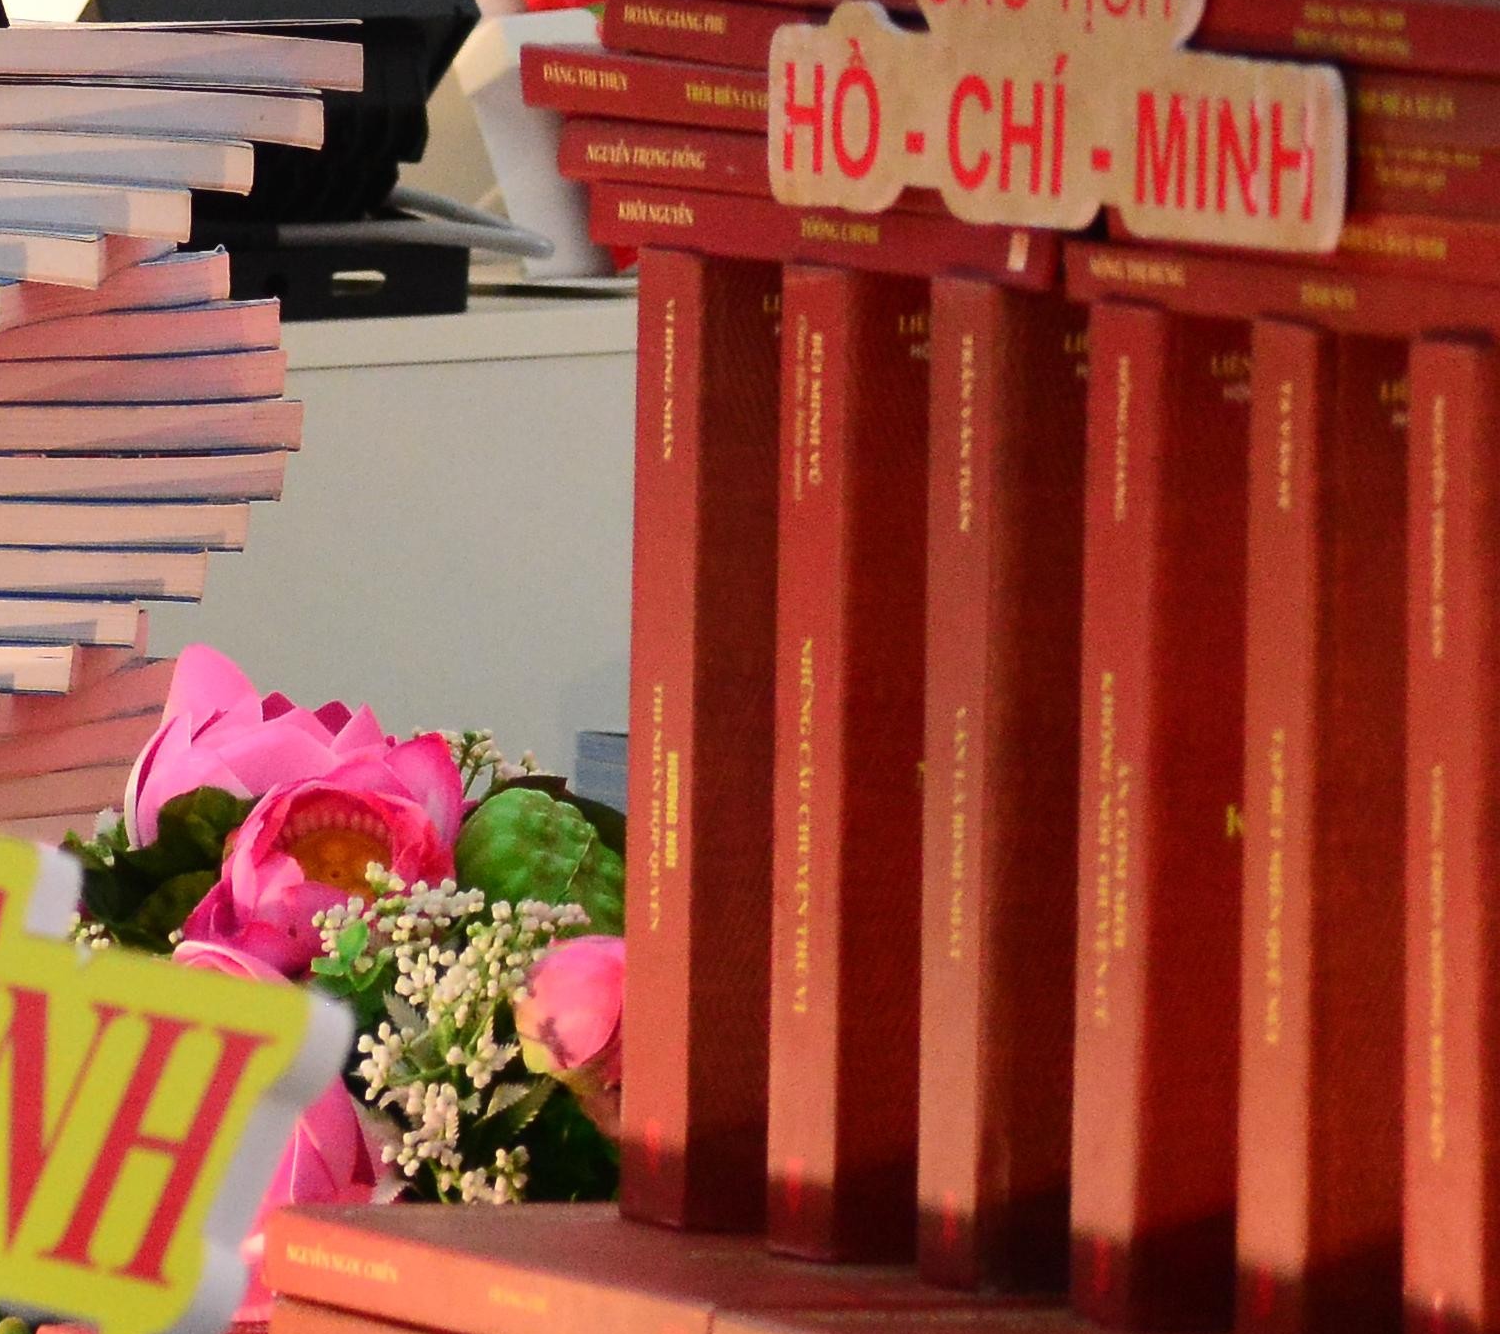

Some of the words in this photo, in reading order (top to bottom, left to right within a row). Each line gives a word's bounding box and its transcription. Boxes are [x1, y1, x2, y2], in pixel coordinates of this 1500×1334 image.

[783, 38, 881, 180] HỒ
[947, 53, 1066, 198] CHÍ
[1134, 91, 1315, 223] MINH
